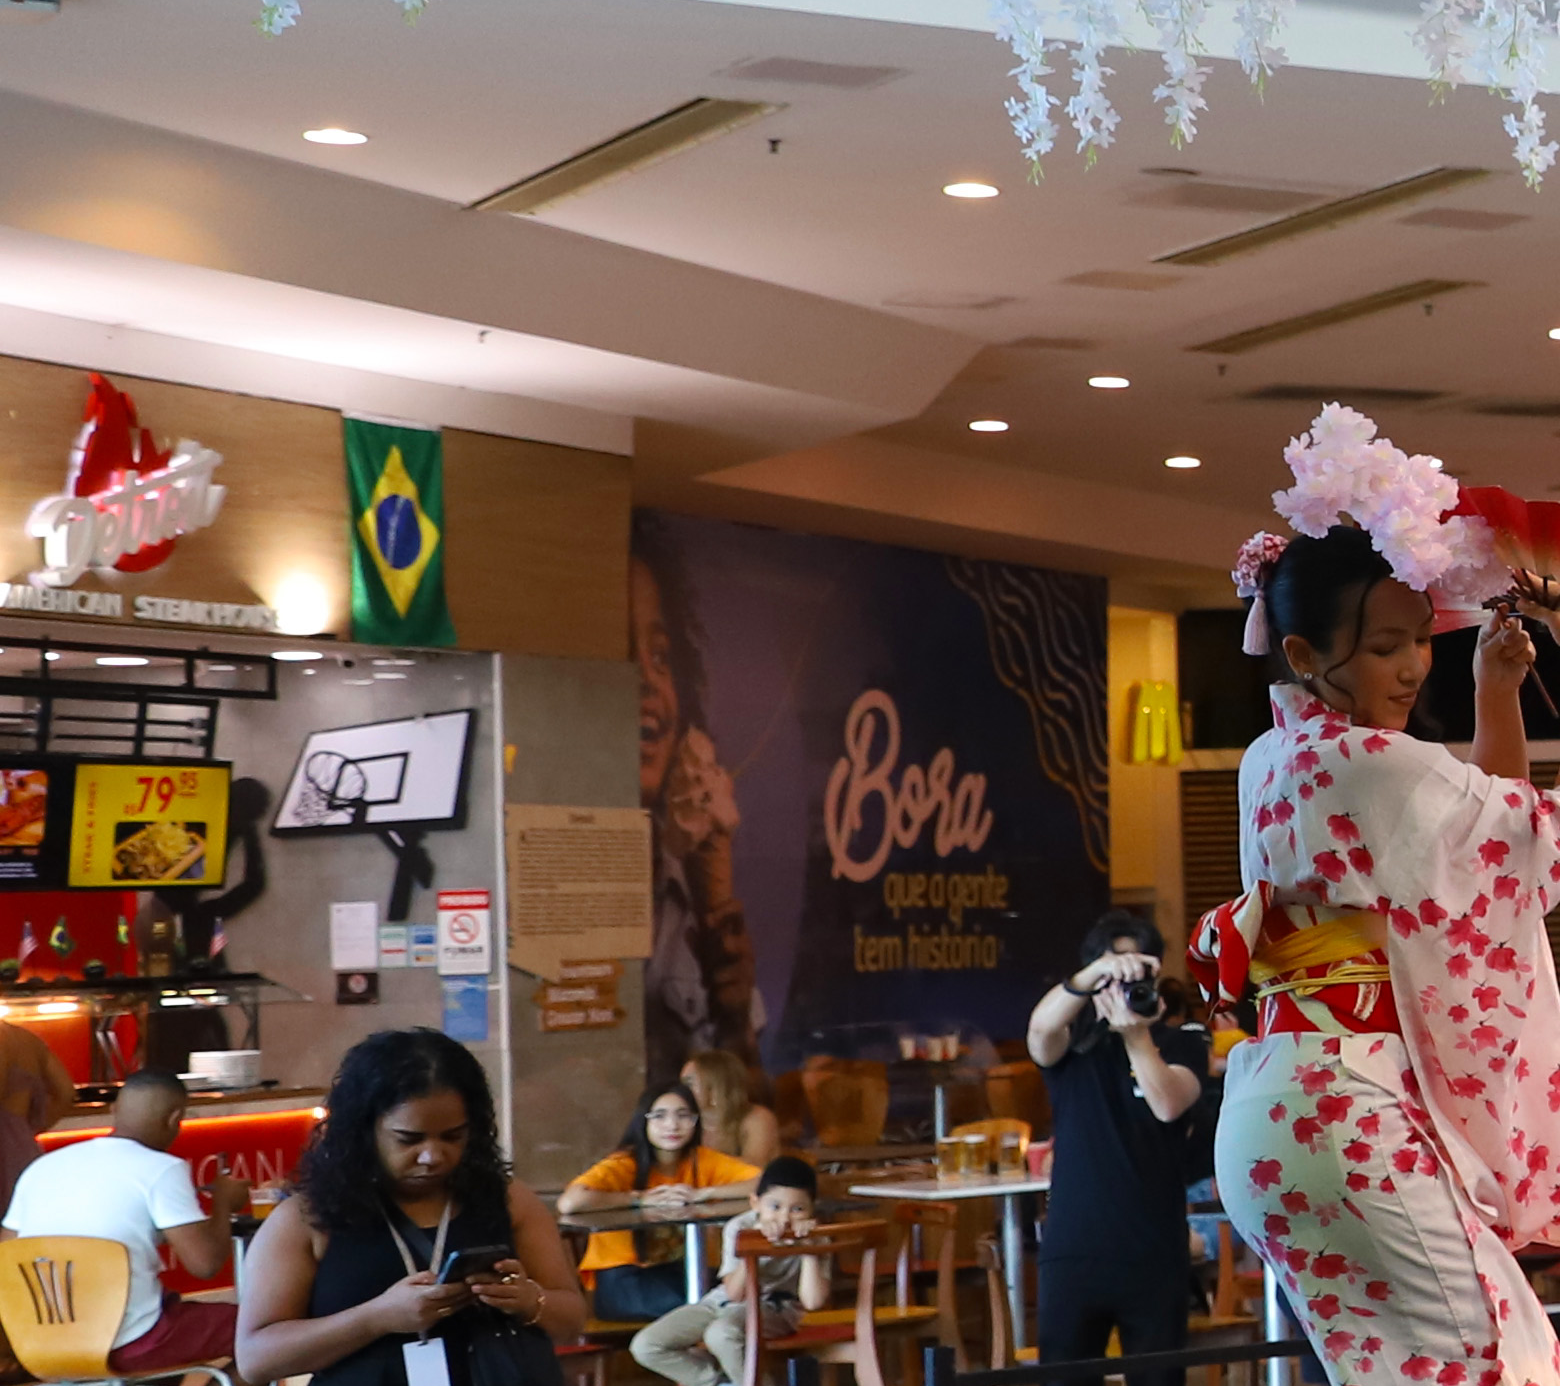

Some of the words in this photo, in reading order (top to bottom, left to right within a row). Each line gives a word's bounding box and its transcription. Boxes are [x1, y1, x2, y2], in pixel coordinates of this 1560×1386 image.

[824, 688, 994, 883] Bora
[884, 872, 928, 919] que
[929, 873, 945, 909] a
[948, 864, 1009, 926] gente
[854, 923, 903, 973] tem
